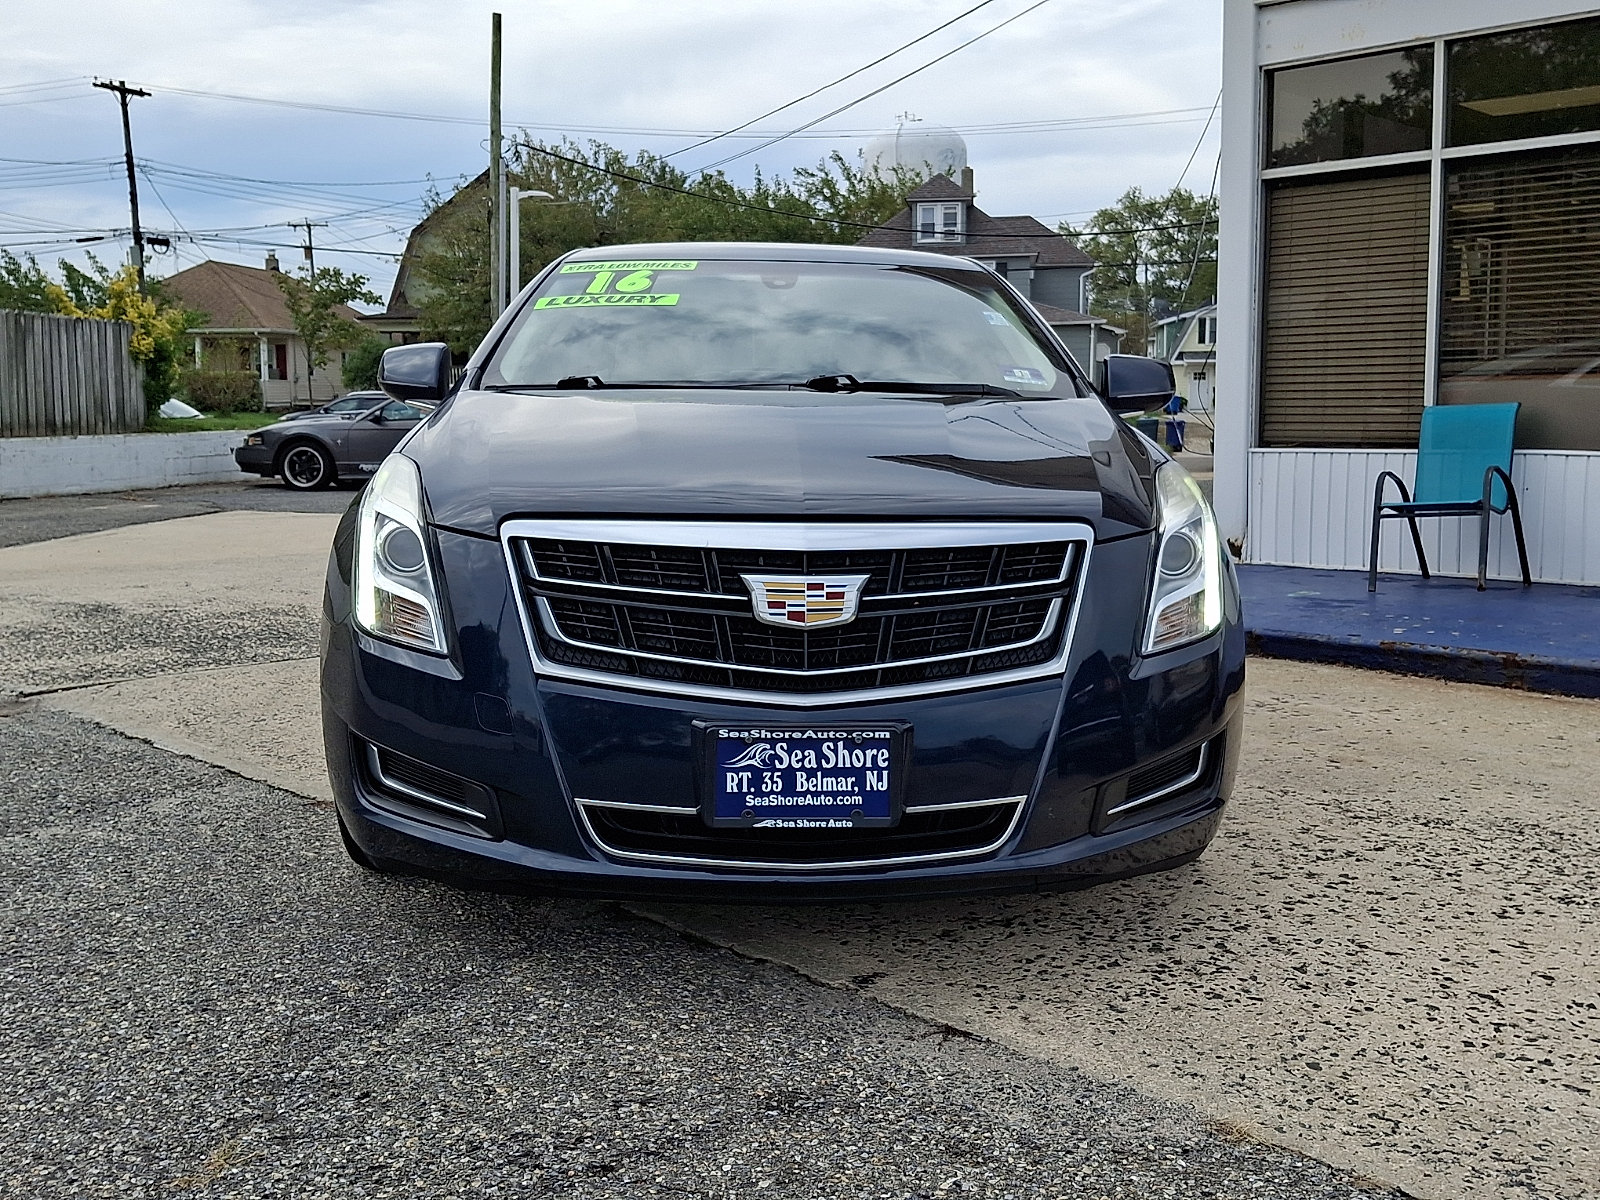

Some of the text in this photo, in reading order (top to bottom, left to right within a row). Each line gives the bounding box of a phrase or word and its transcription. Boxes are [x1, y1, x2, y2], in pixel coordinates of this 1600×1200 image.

[565, 262, 692, 272] XTRA LOW MILES
[586, 270, 654, 294] 16
[545, 295, 667, 306] LUXURY
[718, 729, 891, 739] SeaShoreAuto.com
[775, 741, 889, 769] Sea Shore
[726, 771, 889, 794] RT. 35 Belmar, NJ
[745, 794, 863, 806] SeaShoreAuto.com
[776, 820, 853, 828] Sea Shore Auto
